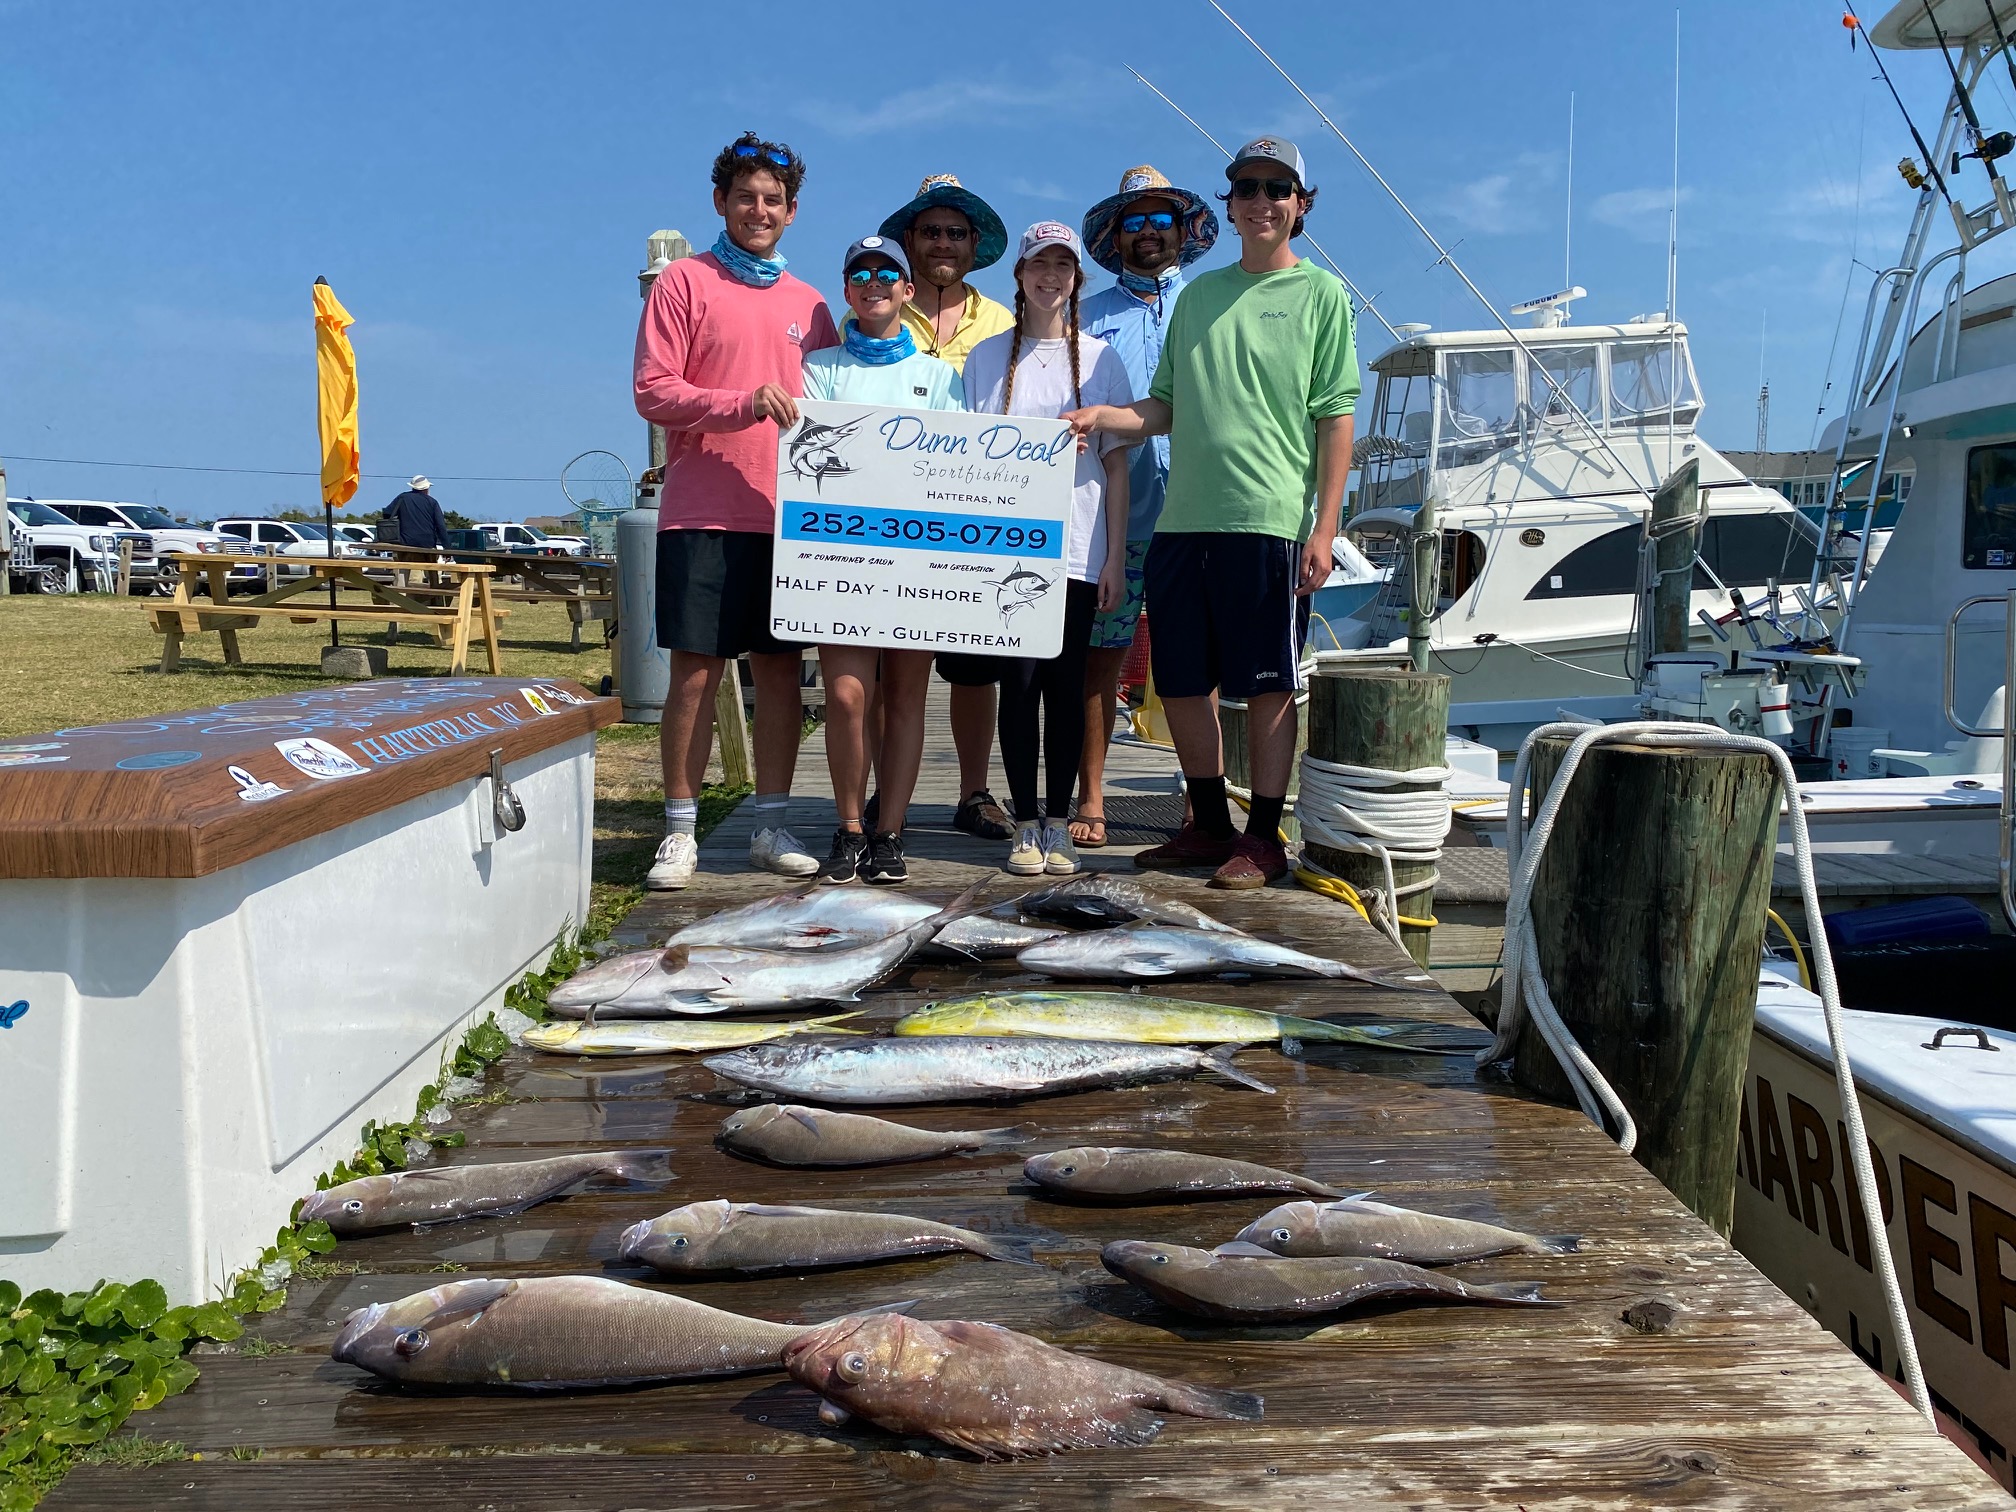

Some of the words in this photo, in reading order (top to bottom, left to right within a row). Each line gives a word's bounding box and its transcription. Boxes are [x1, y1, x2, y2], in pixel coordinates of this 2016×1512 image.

[1524, 294, 1558, 308] FURUNO
[879, 414, 968, 455] Dunn
[978, 423, 1074, 467] Deal
[913, 460, 1031, 489] Sportfishing
[927, 490, 992, 505] HATTERAS,
[997, 496, 1017, 506] NC
[800, 512, 1047, 549] 252-305-0799
[797, 552, 812, 560] AIR
[814, 553, 865, 565] CONDITIONED
[868, 557, 895, 567] SALON
[928, 562, 949, 571] TUNA
[950, 563, 996, 574] GREENSTICK
[775, 575, 828, 592] HALF
[836, 580, 875, 596] DAY
[896, 584, 983, 604] INSHORE
[772, 618, 825, 635] FULL
[832, 621, 872, 638] DAY
[892, 626, 1022, 648] GULFSTREAM
[1256, 671, 1278, 679] adidas
